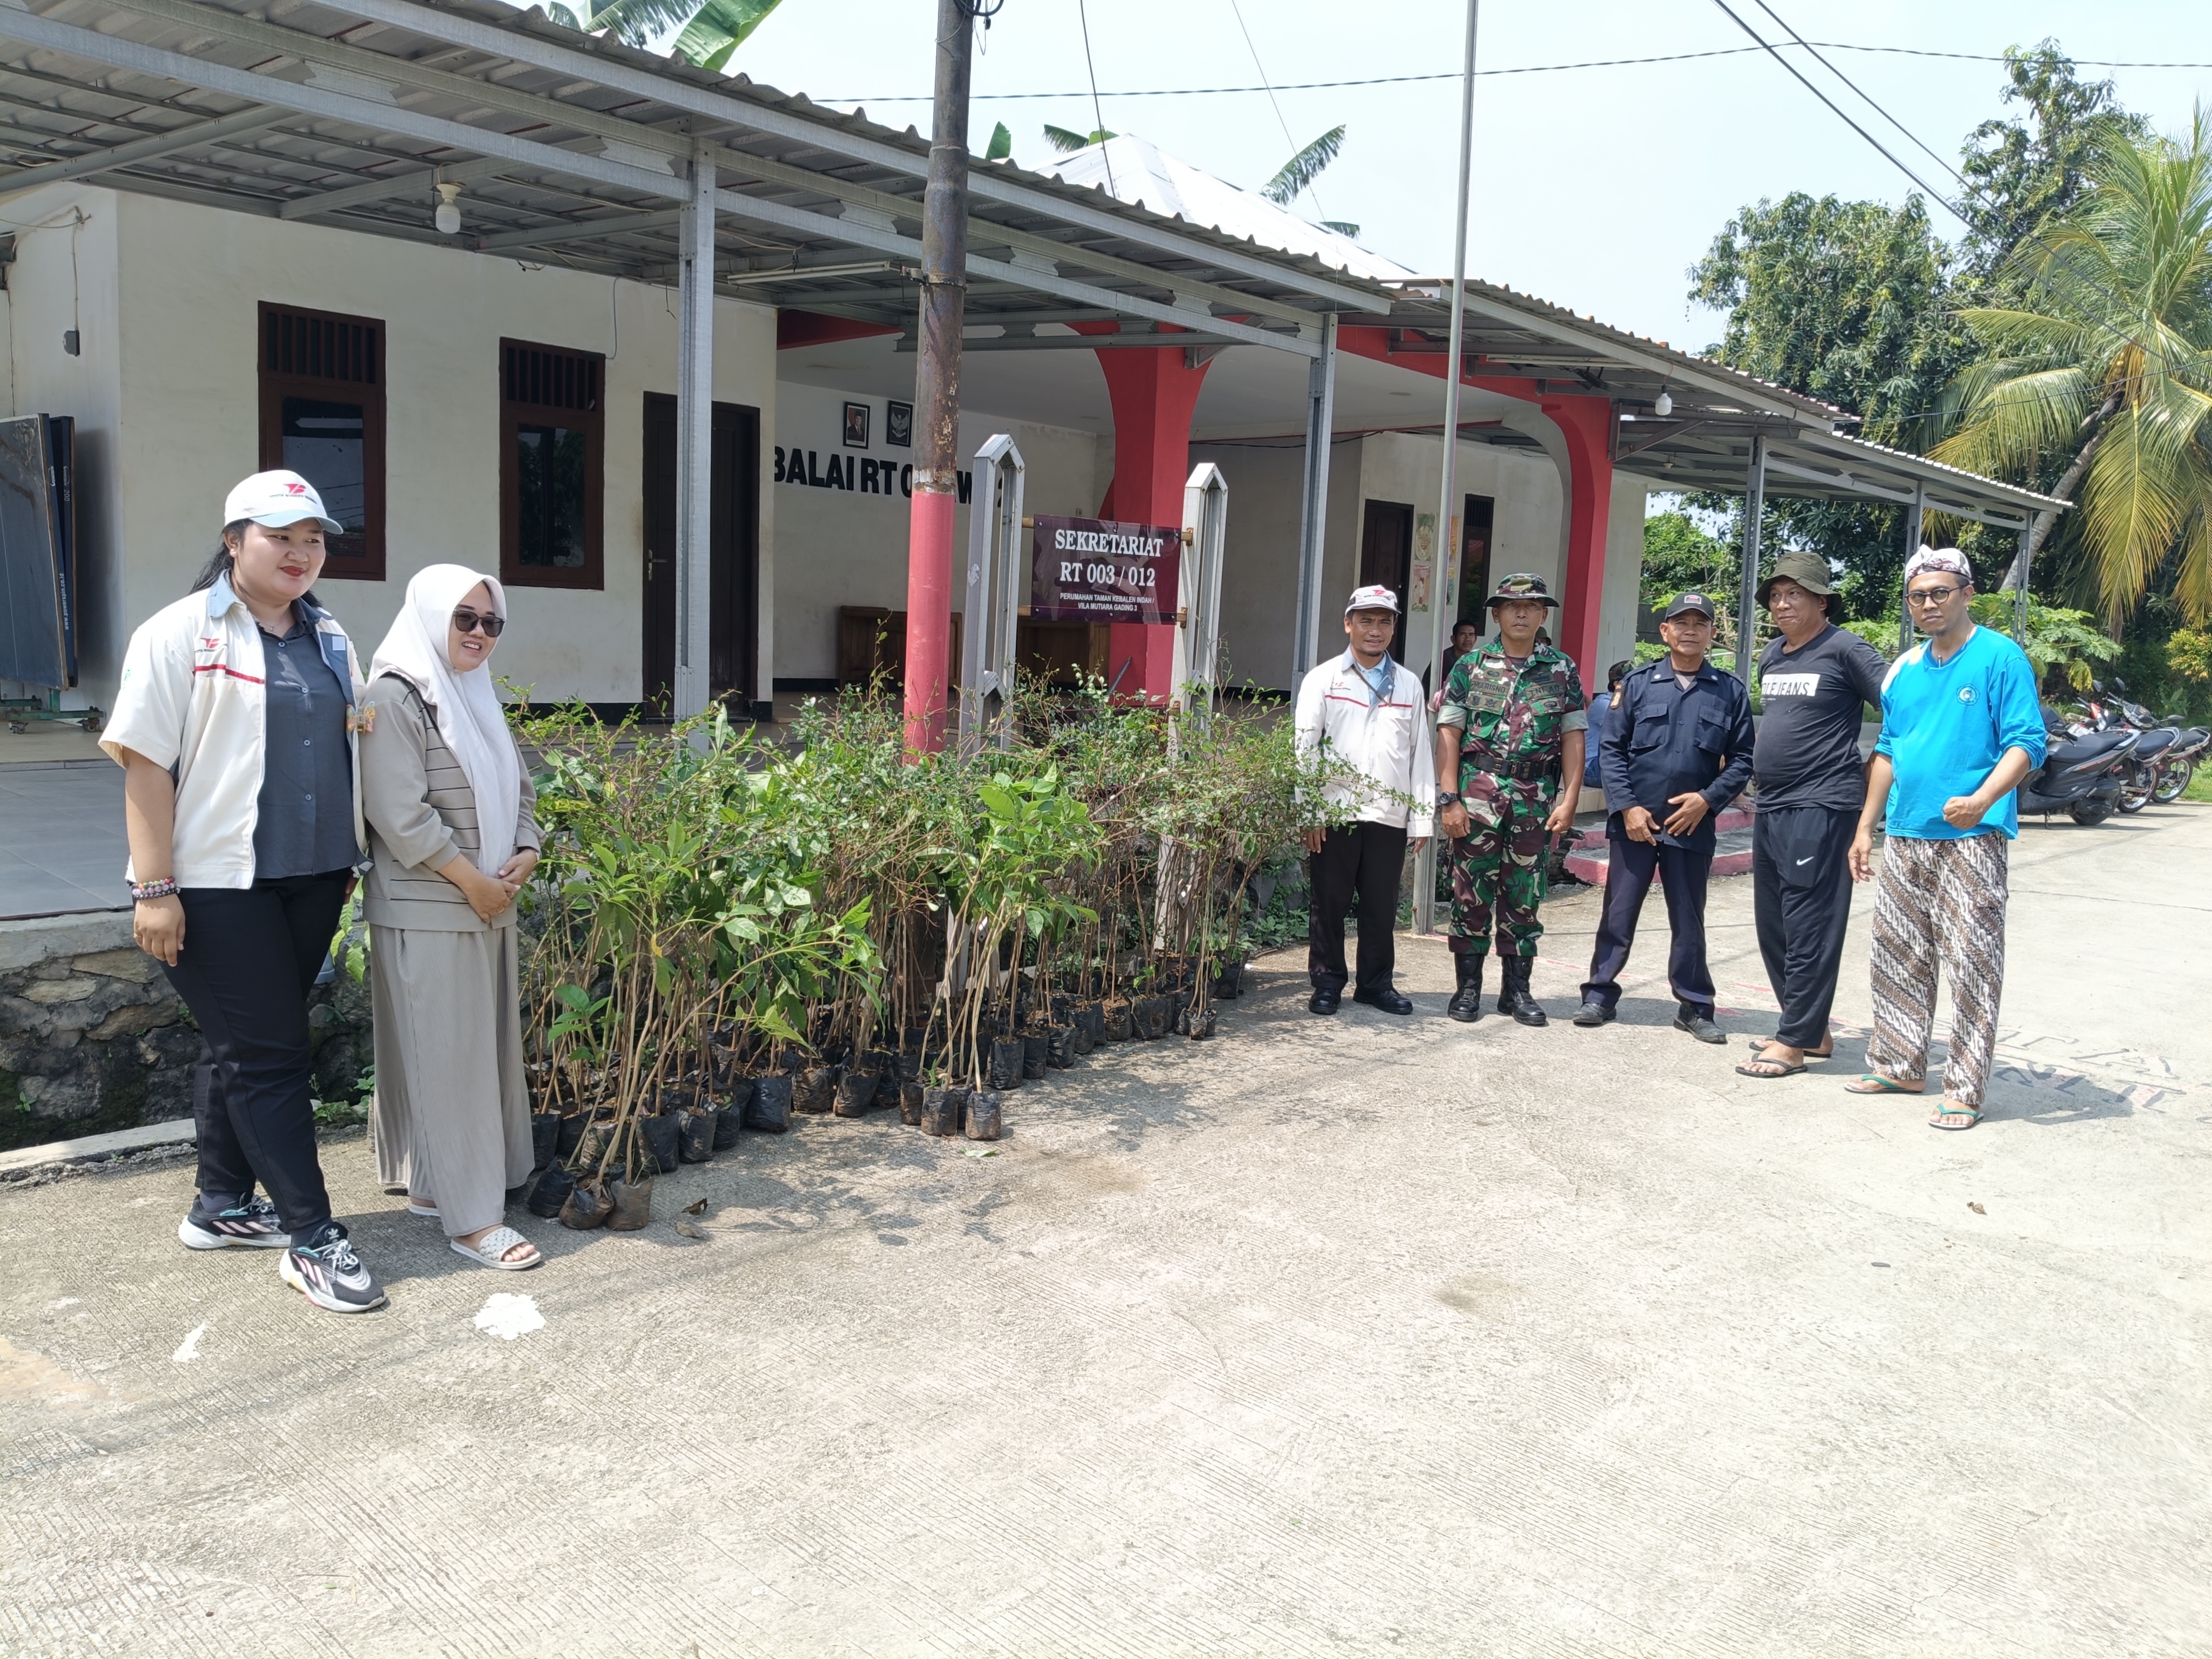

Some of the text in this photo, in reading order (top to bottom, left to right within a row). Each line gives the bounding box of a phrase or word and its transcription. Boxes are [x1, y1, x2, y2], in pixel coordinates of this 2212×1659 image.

[774, 446, 854, 491] BALAI
[861, 457, 898, 495] RT
[954, 470, 972, 504] W
[1055, 529, 1163, 557] SEKRETARIAT
[1060, 562, 1083, 582] RT
[1087, 564, 1115, 584] 003
[1129, 567, 1155, 587] 012
[59, 573, 69, 630] www.powerspin.co.id
[1060, 593, 1093, 601] PERUMAHAN
[1529, 685, 1560, 697] TNI AD
